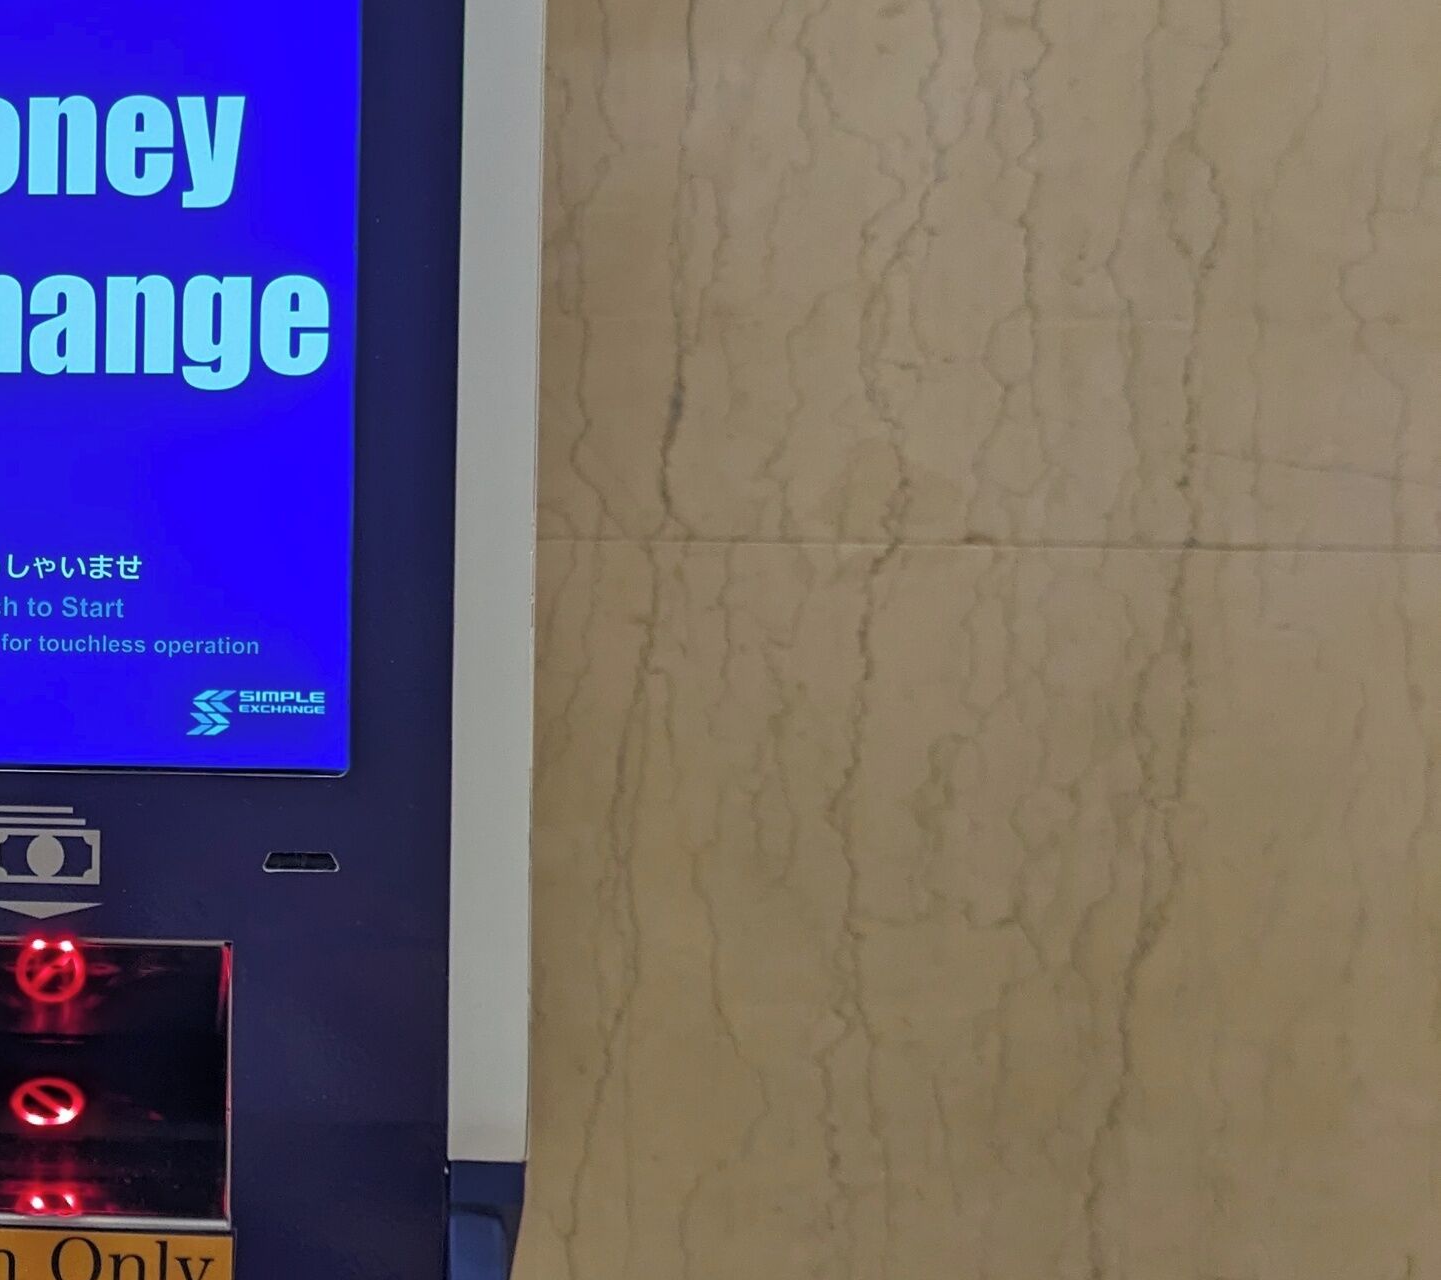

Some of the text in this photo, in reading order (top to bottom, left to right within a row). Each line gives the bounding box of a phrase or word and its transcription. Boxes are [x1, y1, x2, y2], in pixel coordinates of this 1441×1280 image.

[27, 596, 53, 618] to
[61, 596, 125, 619] Start
[1, 632, 33, 653] for
[38, 633, 147, 654] touchless
[153, 634, 260, 658] operation
[239, 690, 326, 704] SIMPLE
[239, 705, 326, 715] EXCHANGE
